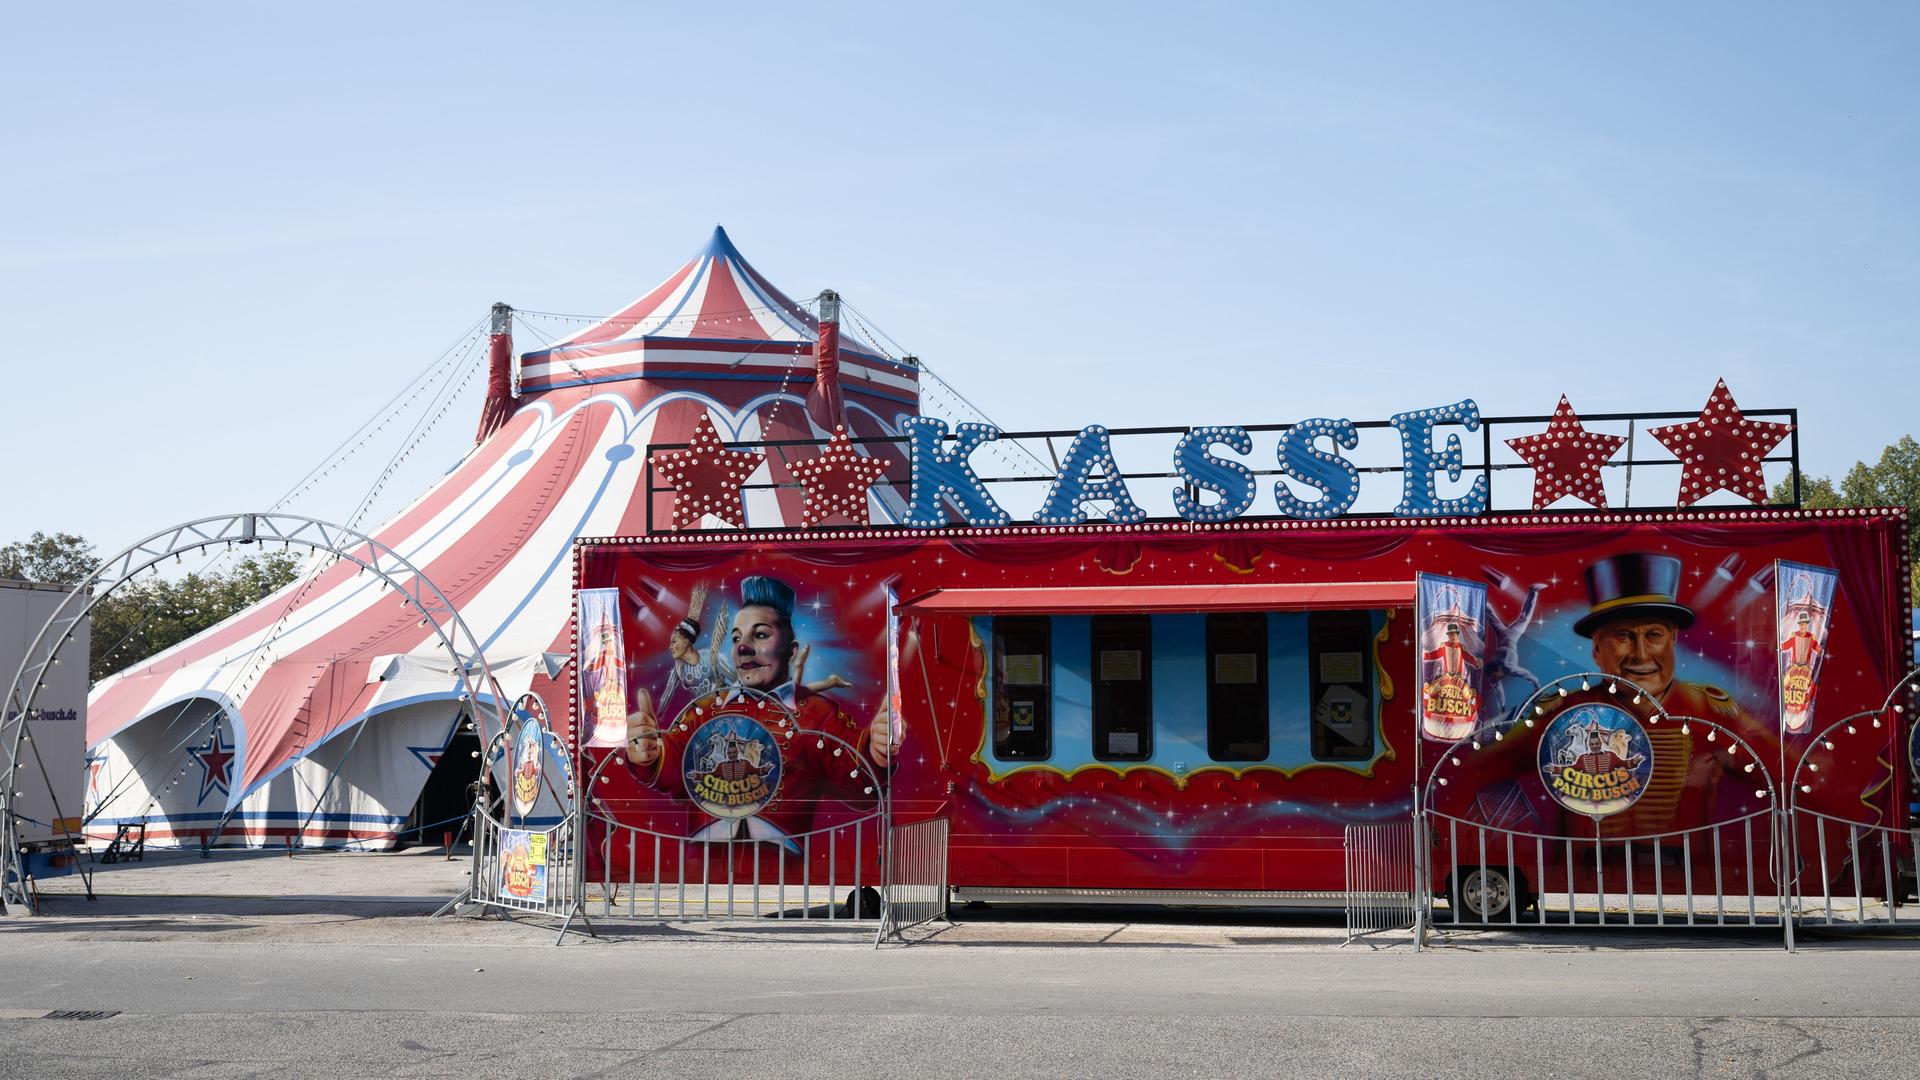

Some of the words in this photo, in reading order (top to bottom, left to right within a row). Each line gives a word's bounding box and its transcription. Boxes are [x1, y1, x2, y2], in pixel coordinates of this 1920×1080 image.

[902, 398, 1488, 527] KASSE
[1427, 698, 1472, 716] BUSCH
[703, 774, 761, 794] CIRCUS
[1552, 776, 1590, 800] PAUL
[1592, 777, 1641, 801] BUSCH
[1563, 767, 1630, 789] CIRCUS
[694, 783, 726, 804] PAUL
[728, 784, 769, 806] BUSCH
